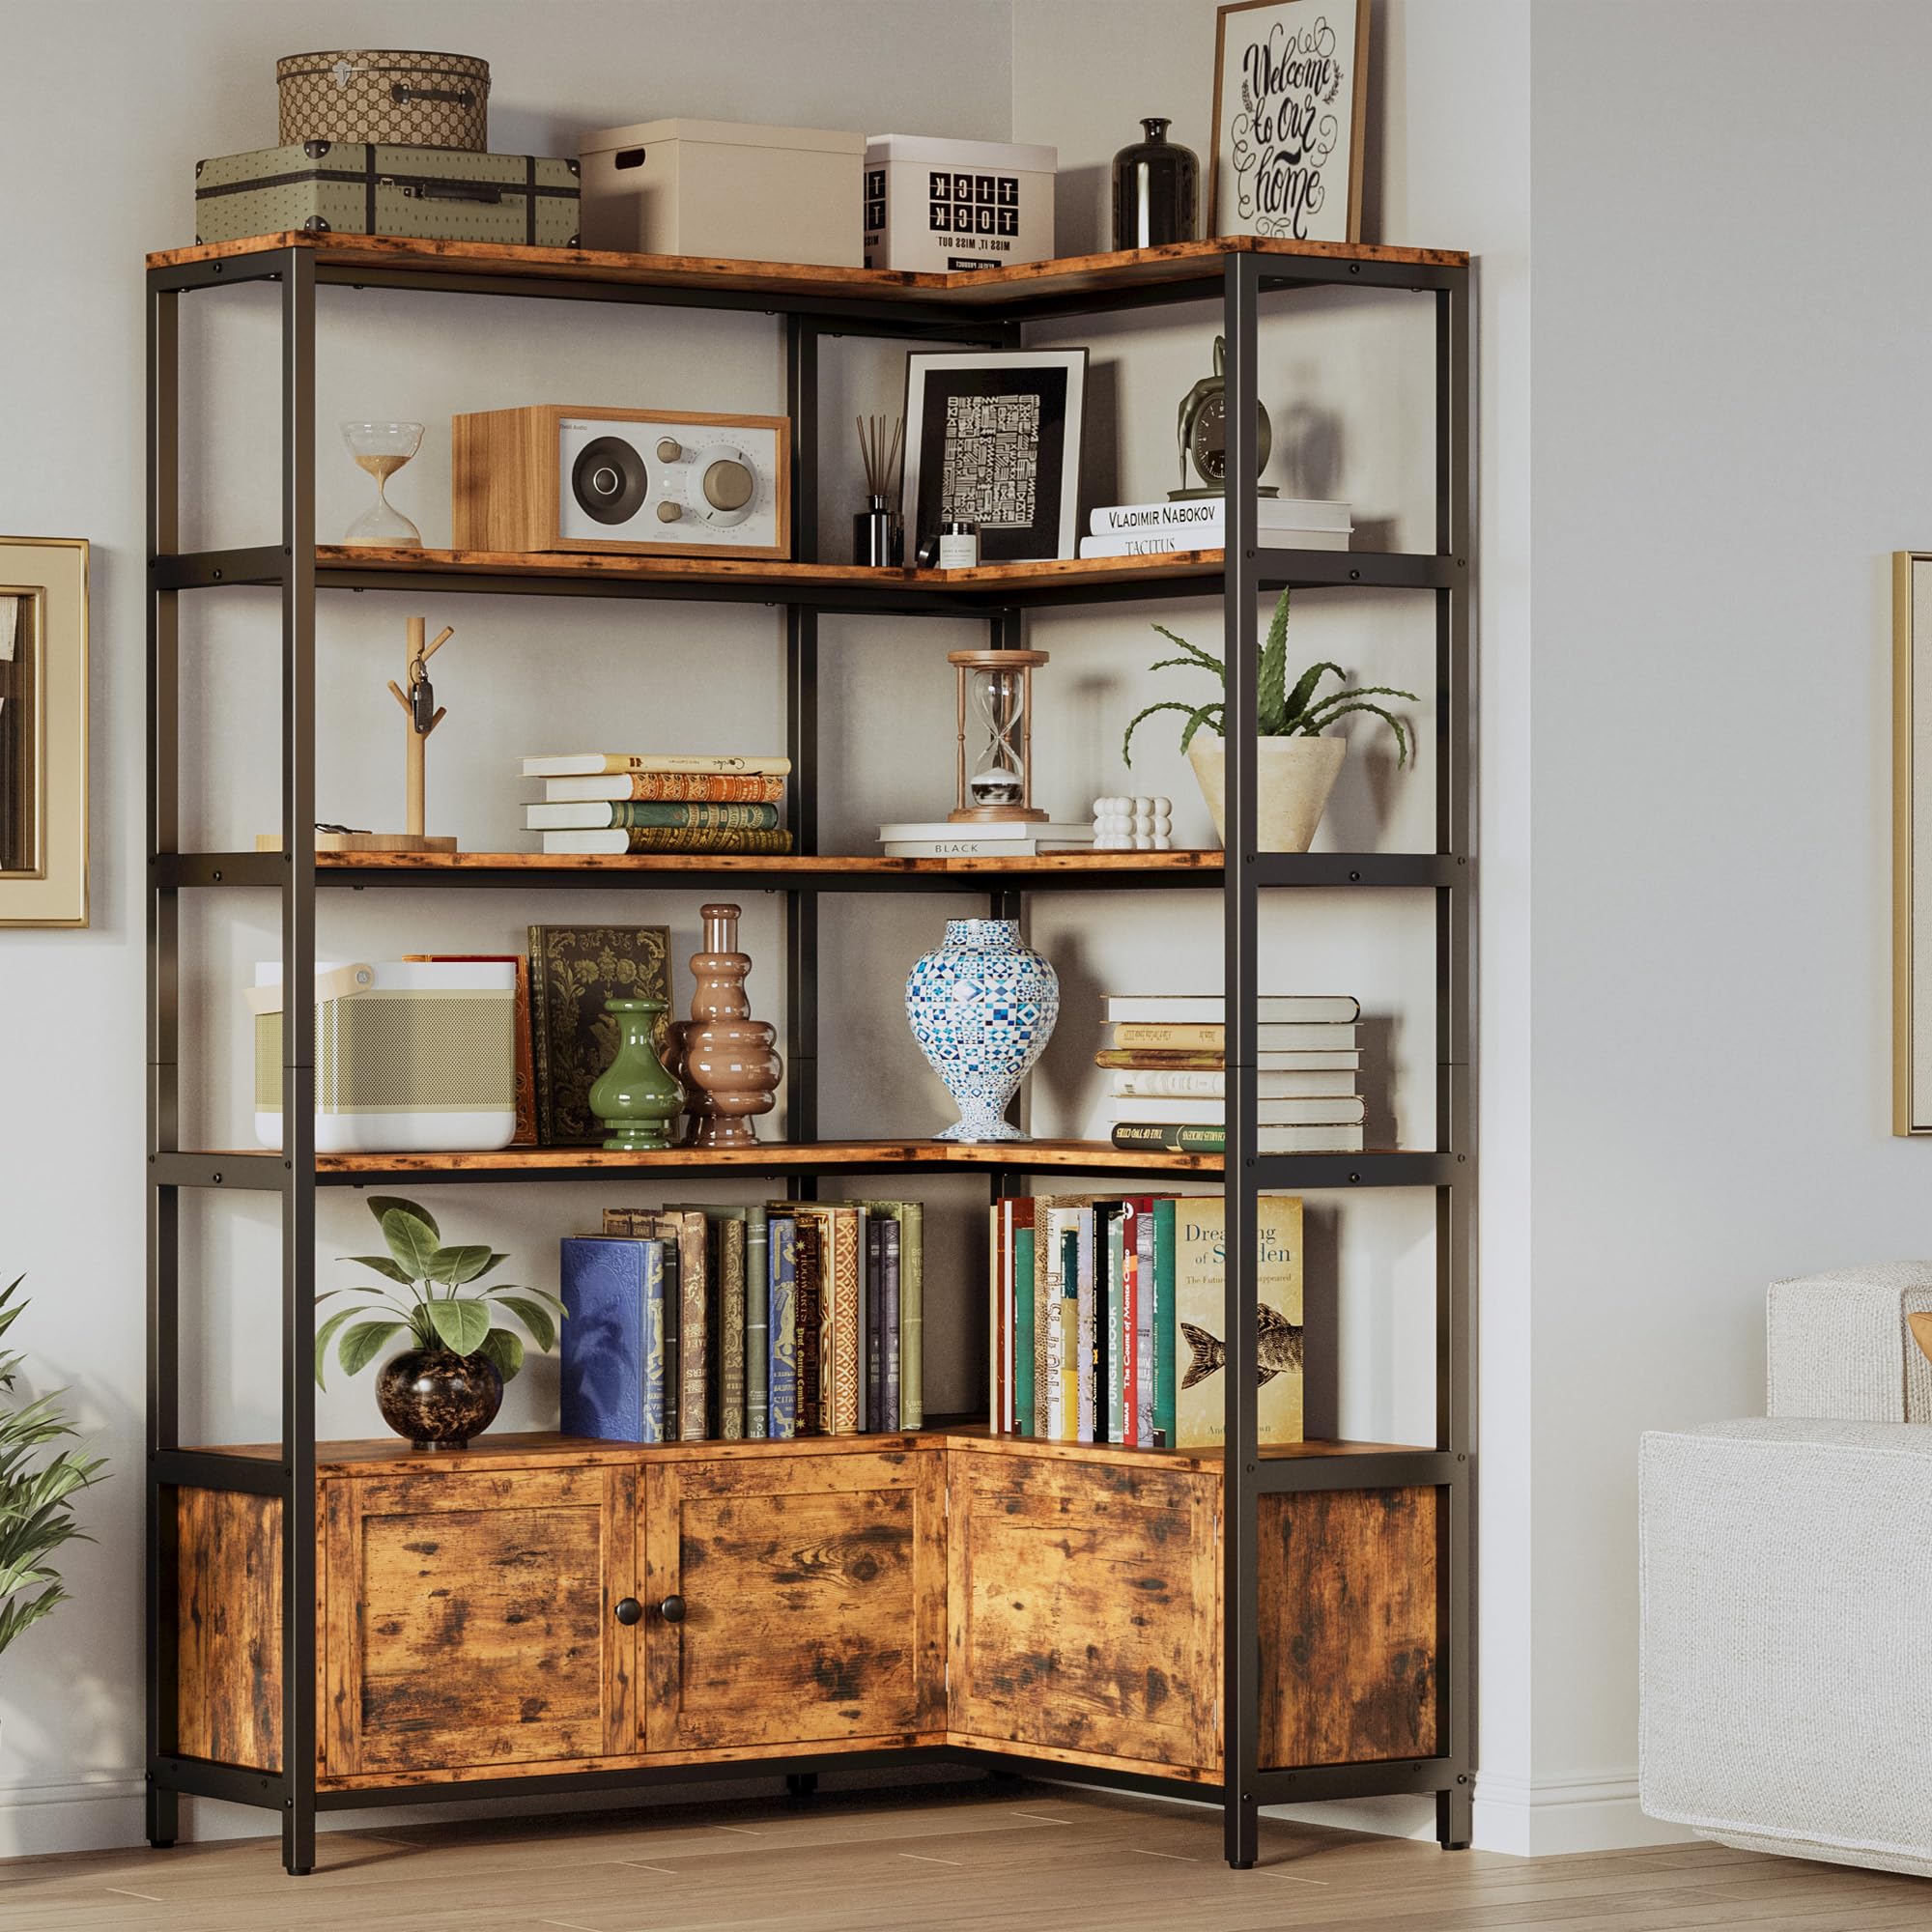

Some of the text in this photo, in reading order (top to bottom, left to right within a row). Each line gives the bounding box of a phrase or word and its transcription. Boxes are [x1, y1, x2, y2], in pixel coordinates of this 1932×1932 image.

[1243, 23, 1330, 99] Welcome
[1250, 97, 1272, 145] to
[1255, 146, 1321, 240] home
[1109, 505, 1216, 528] VLADIMIR NABOKOV
[1125, 537, 1176, 556] TACITUS
[935, 843, 979, 853] BLACK
[1195, 1251, 1208, 1264] of
[1186, 1275, 1202, 1285] The
[1123, 1320, 1130, 1331] of
[1108, 1306, 1118, 1406] JUNGLE BOOK
